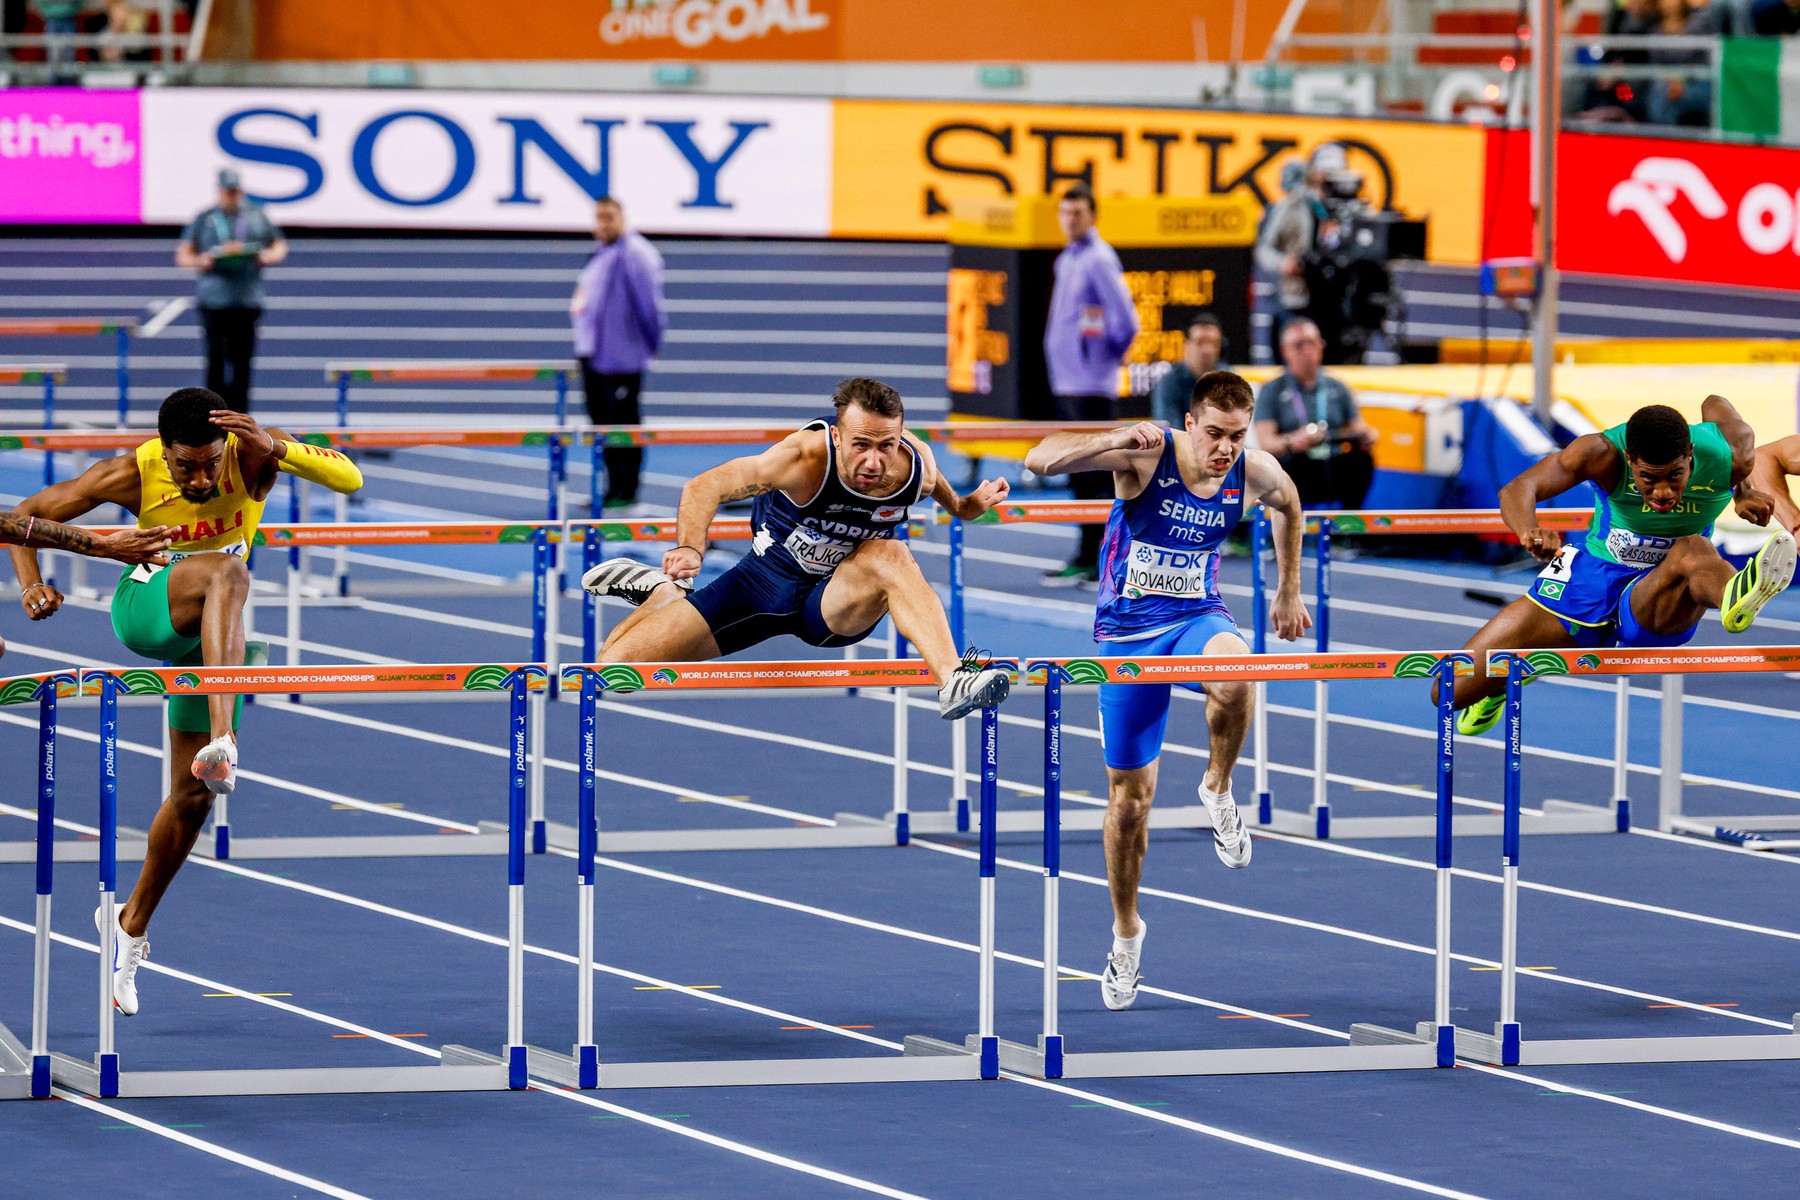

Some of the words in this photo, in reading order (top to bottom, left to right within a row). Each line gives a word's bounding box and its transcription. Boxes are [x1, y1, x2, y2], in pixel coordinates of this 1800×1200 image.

[672, 0, 830, 48] GOAL
[217, 108, 770, 208] SONY
[925, 121, 1393, 216] SEIKO
[1158, 499, 1226, 528] SERBIA
[1641, 499, 1700, 513] BSIL
[1168, 524, 1206, 543] mts
[791, 534, 850, 565] TRAJKO
[1153, 549, 1204, 569] TDK
[1129, 567, 1202, 592] NOVAKOVIĆ
[1144, 665, 1173, 673] WORLD
[1173, 664, 1214, 673] ATHLETICS
[1215, 664, 1246, 672] INDOOR
[1246, 662, 1310, 672] CHAMPIONSHIPS
[1310, 662, 1340, 670] KUJAWY
[1341, 661, 1376, 669] POMORZE
[1377, 661, 1387, 669] 26
[1604, 657, 1631, 665] WORLD
[1632, 657, 1672, 665] ATHLETICS
[1673, 656, 1703, 664] INDOOR
[1703, 655, 1765, 664] CHAMPIONSHIPS
[204, 676, 233, 684] WORLD
[234, 675, 276, 684] ATHLETICS
[278, 675, 309, 683] INDOOR
[310, 674, 376, 683] CHAMPIONSHIPS
[377, 674, 407, 682] KUJAWY
[409, 673, 445, 681] POMORZE
[446, 673, 457, 681] 26
[681, 671, 710, 680] WORLD
[711, 671, 753, 679] ATHLETICS
[754, 670, 785, 678] INDOOR
[786, 669, 850, 678] CHAMPIONSHIPS
[851, 669, 881, 677] KUJAWY
[882, 668, 918, 676] POMORZE
[920, 668, 930, 676] 26
